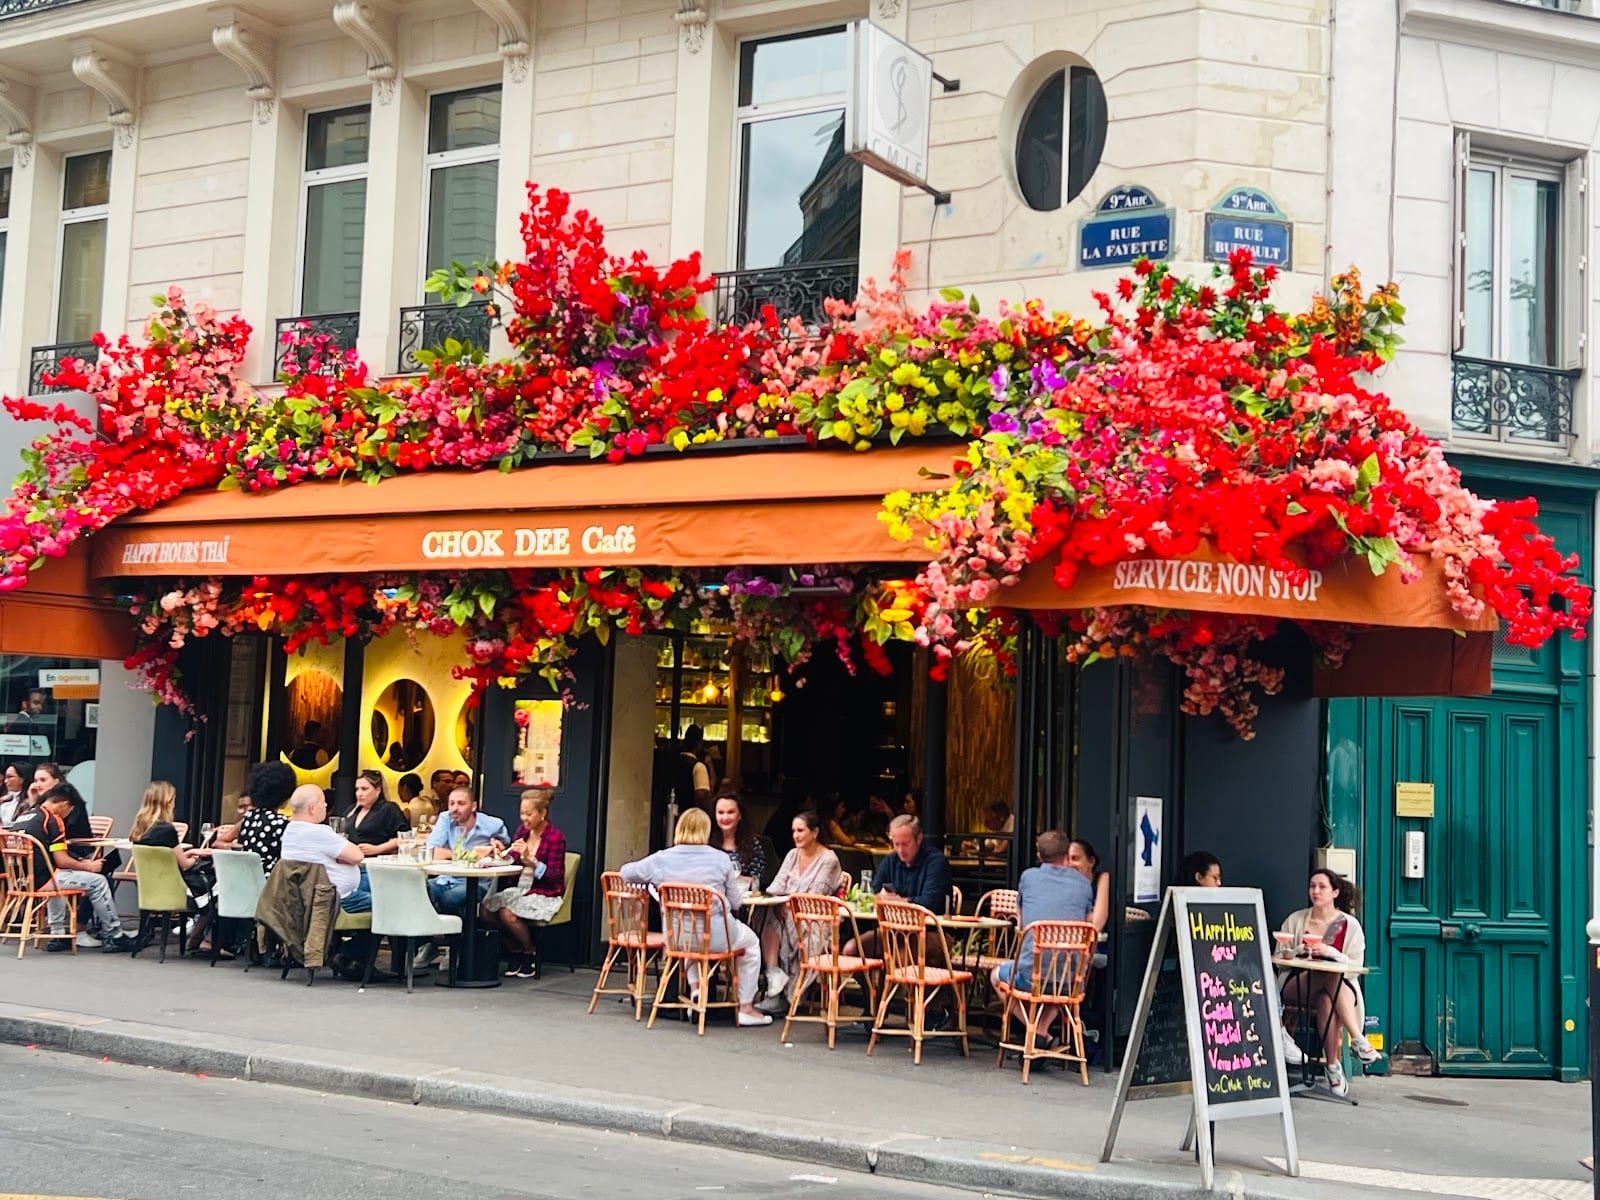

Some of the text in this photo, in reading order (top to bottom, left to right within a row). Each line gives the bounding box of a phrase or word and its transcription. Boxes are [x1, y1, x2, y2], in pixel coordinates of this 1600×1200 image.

[1110, 226, 1140, 241] RUE
[1234, 227, 1263, 241] RUE
[1082, 239, 1168, 260] LA FAYETTE
[122, 543, 160, 564] HAPPY
[158, 541, 200, 563] HOURS
[422, 525, 636, 558] CHOK DEE Café
[1113, 559, 1212, 593] SERVICE
[1215, 562, 1266, 597] NON
